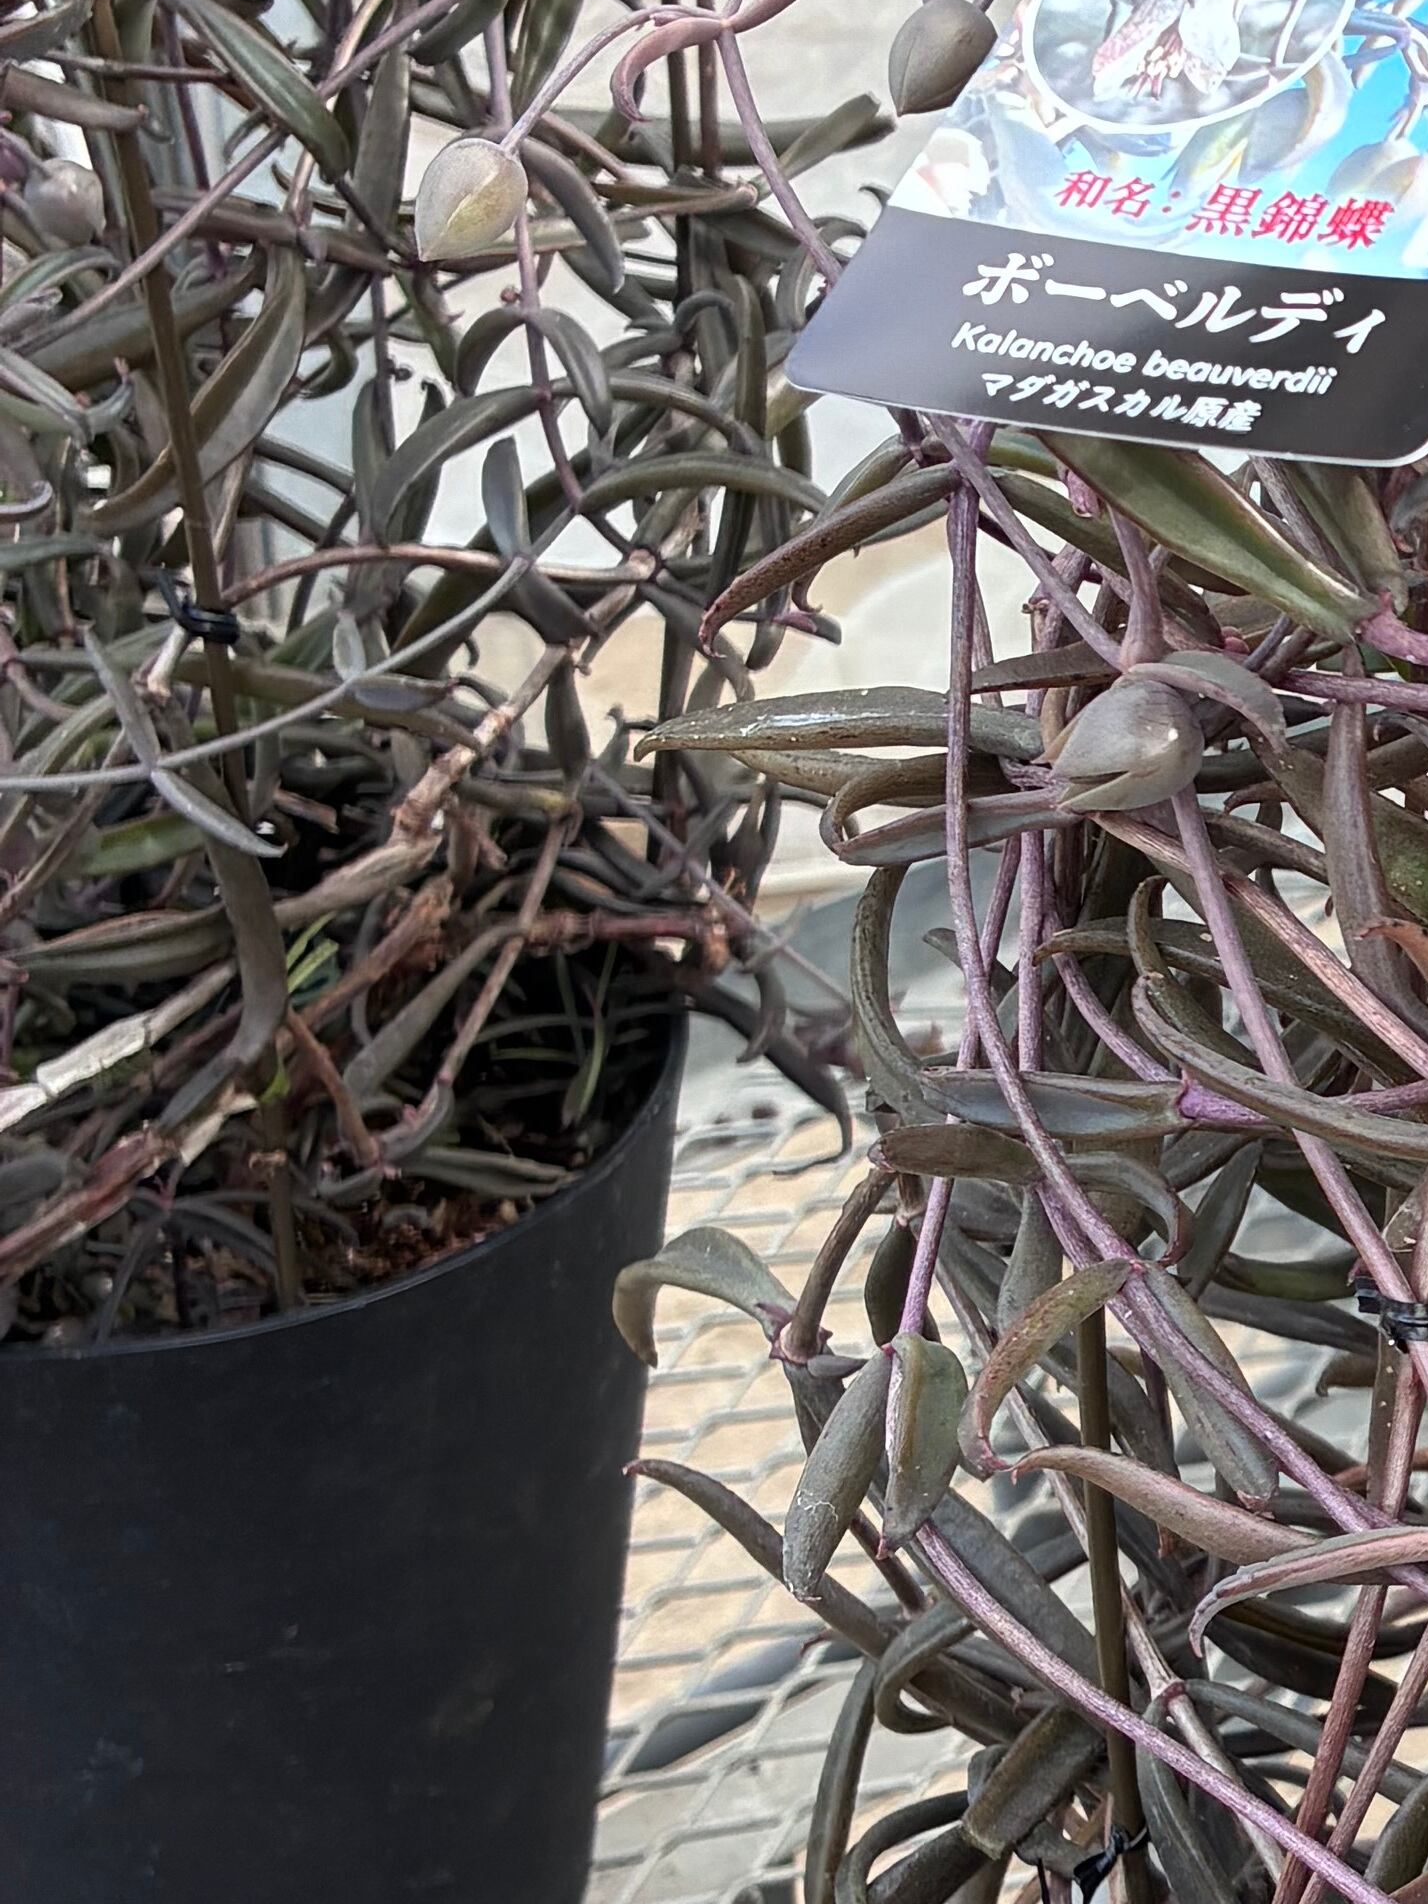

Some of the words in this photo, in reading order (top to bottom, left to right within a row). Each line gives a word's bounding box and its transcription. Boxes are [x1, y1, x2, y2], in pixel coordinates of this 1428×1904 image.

[962, 252, 1387, 354] ボーベルディ
[951, 321, 1137, 374] Kalanchoe
[1142, 349, 1338, 395] beauverdii
[981, 372, 1263, 434] マダガスカル原産
